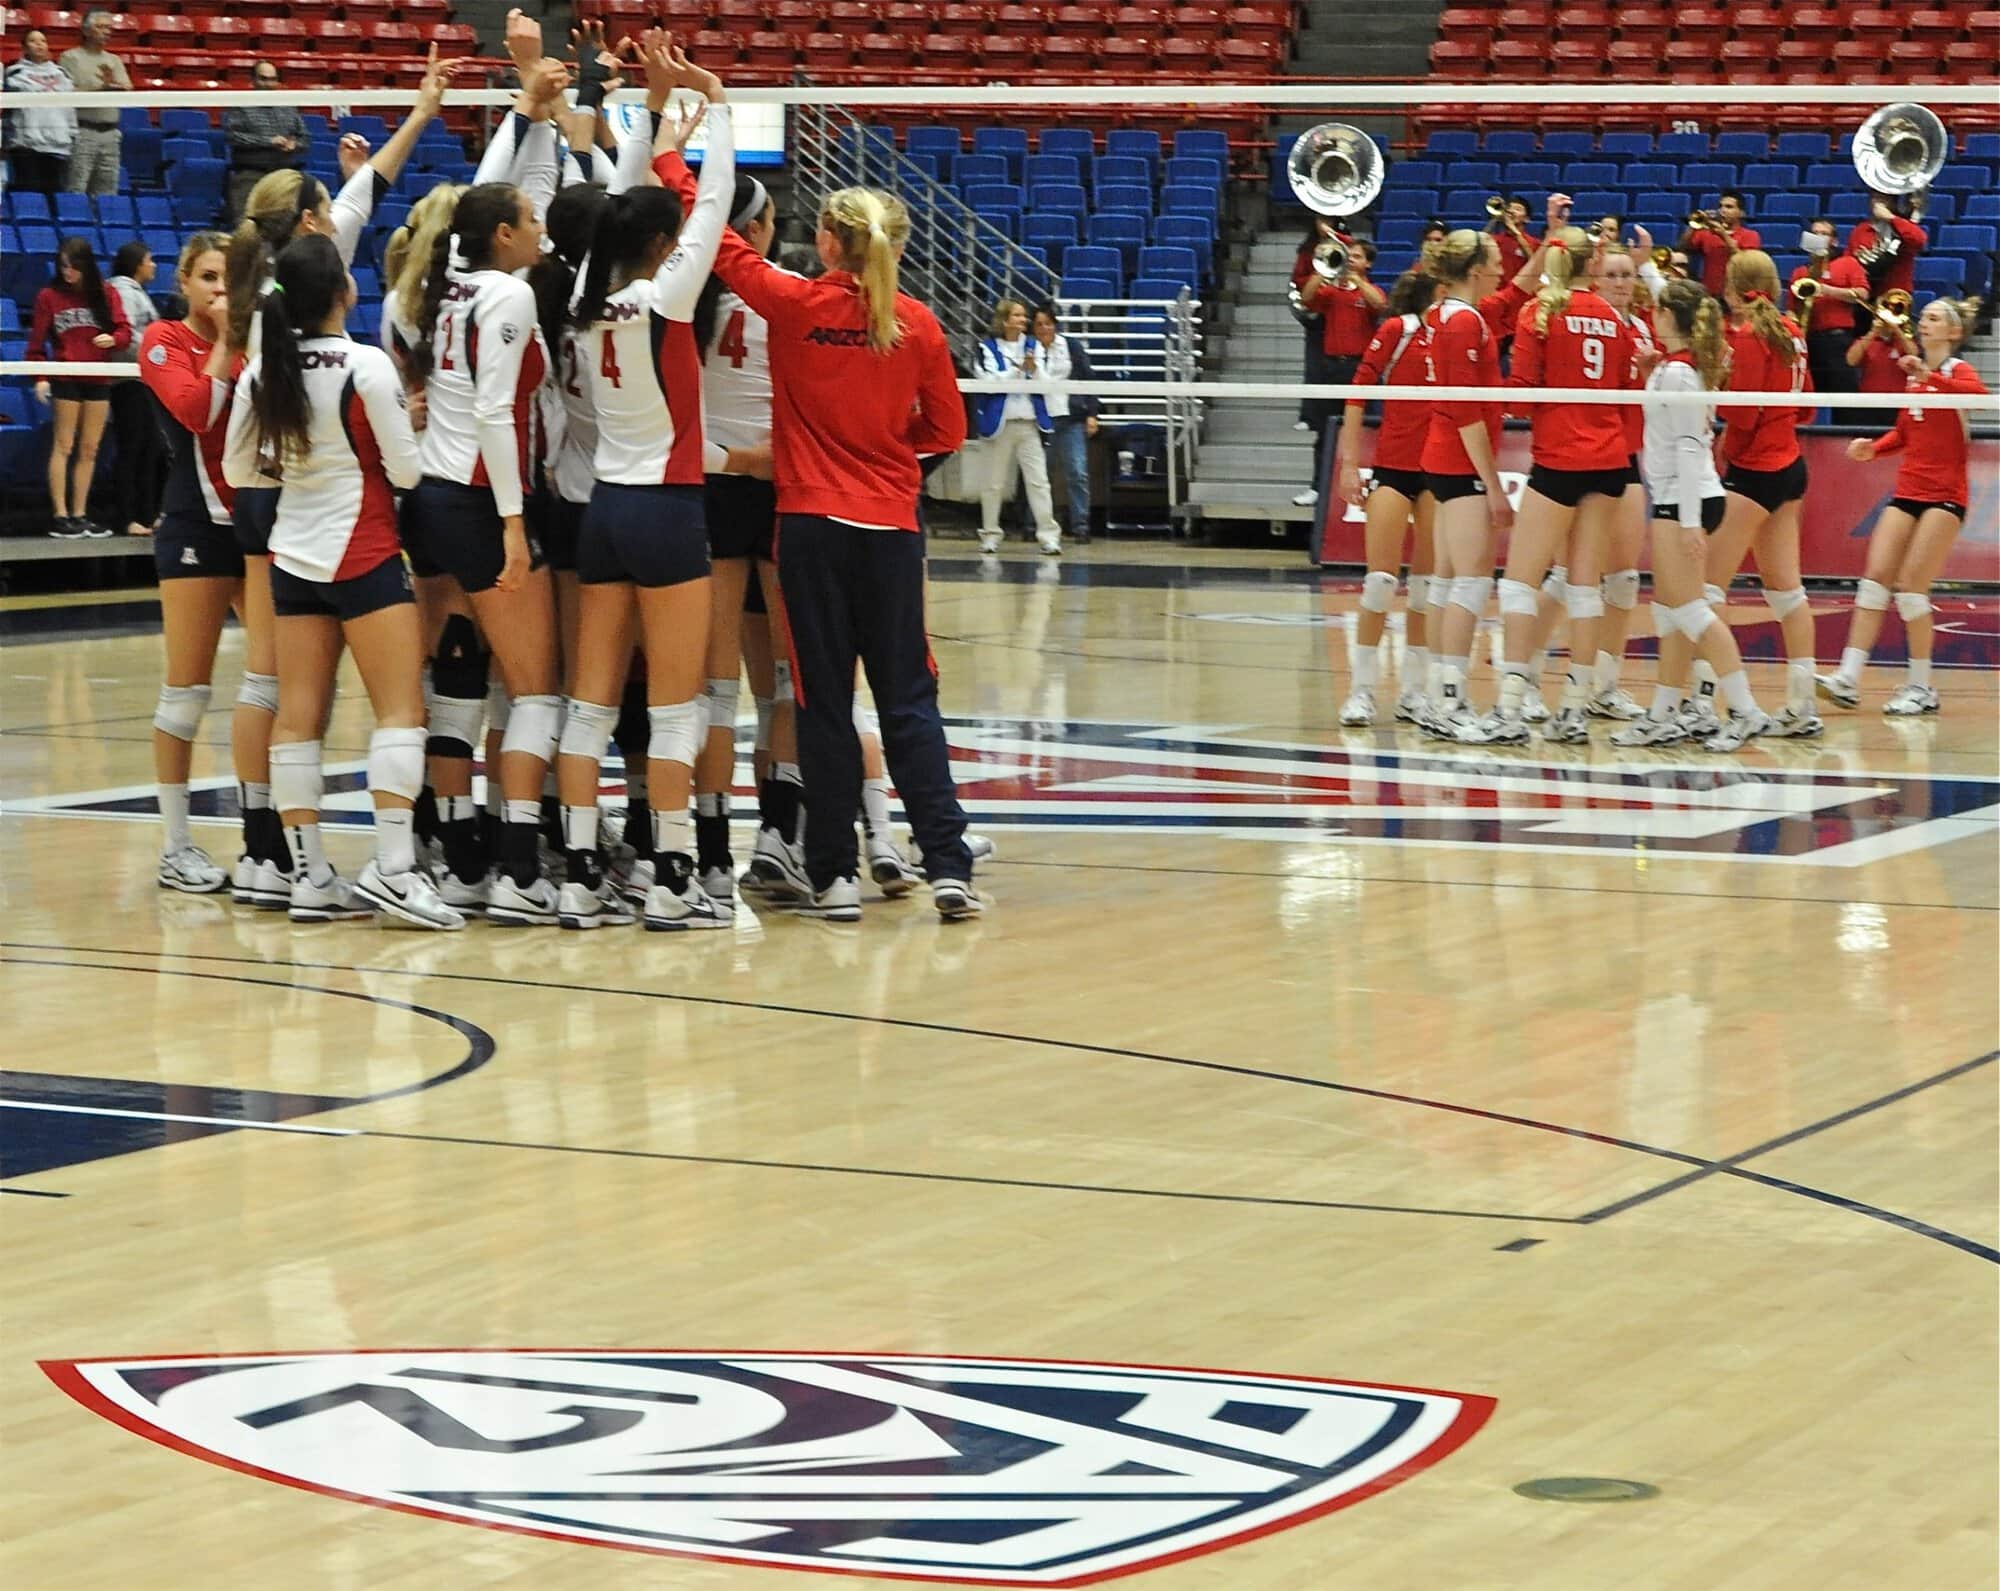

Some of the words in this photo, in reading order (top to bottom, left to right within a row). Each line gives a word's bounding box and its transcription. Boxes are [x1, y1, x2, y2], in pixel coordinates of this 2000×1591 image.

[718, 309, 749, 369] 4
[804, 326, 868, 347] ARIZO
[1565, 316, 1617, 338] UTAH
[601, 329, 622, 389] 4
[1582, 338, 1605, 380] 9
[236, 1367, 702, 1455] 12
[465, 1361, 1398, 1568] PAC
